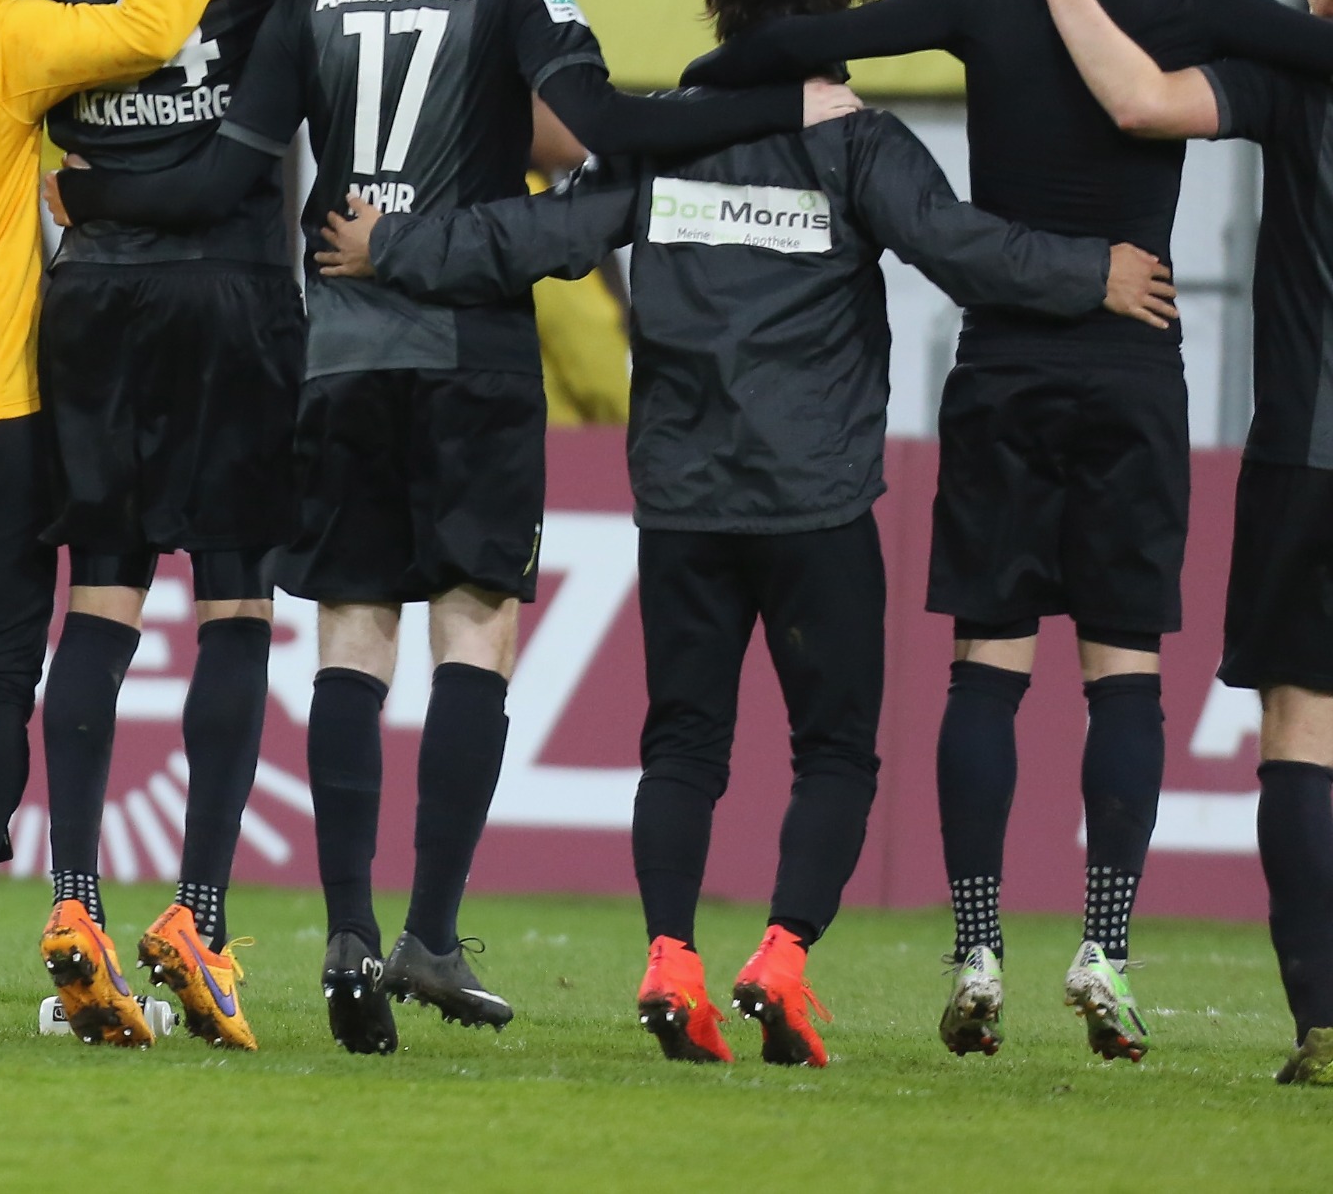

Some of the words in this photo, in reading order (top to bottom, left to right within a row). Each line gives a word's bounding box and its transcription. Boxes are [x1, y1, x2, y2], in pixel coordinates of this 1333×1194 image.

[73, 83, 232, 127] ACKENBERG
[342, 7, 450, 176] 17
[652, 195, 830, 231] DocMorris
[676, 227, 711, 241] Meine
[741, 232, 801, 249] Apotheke
